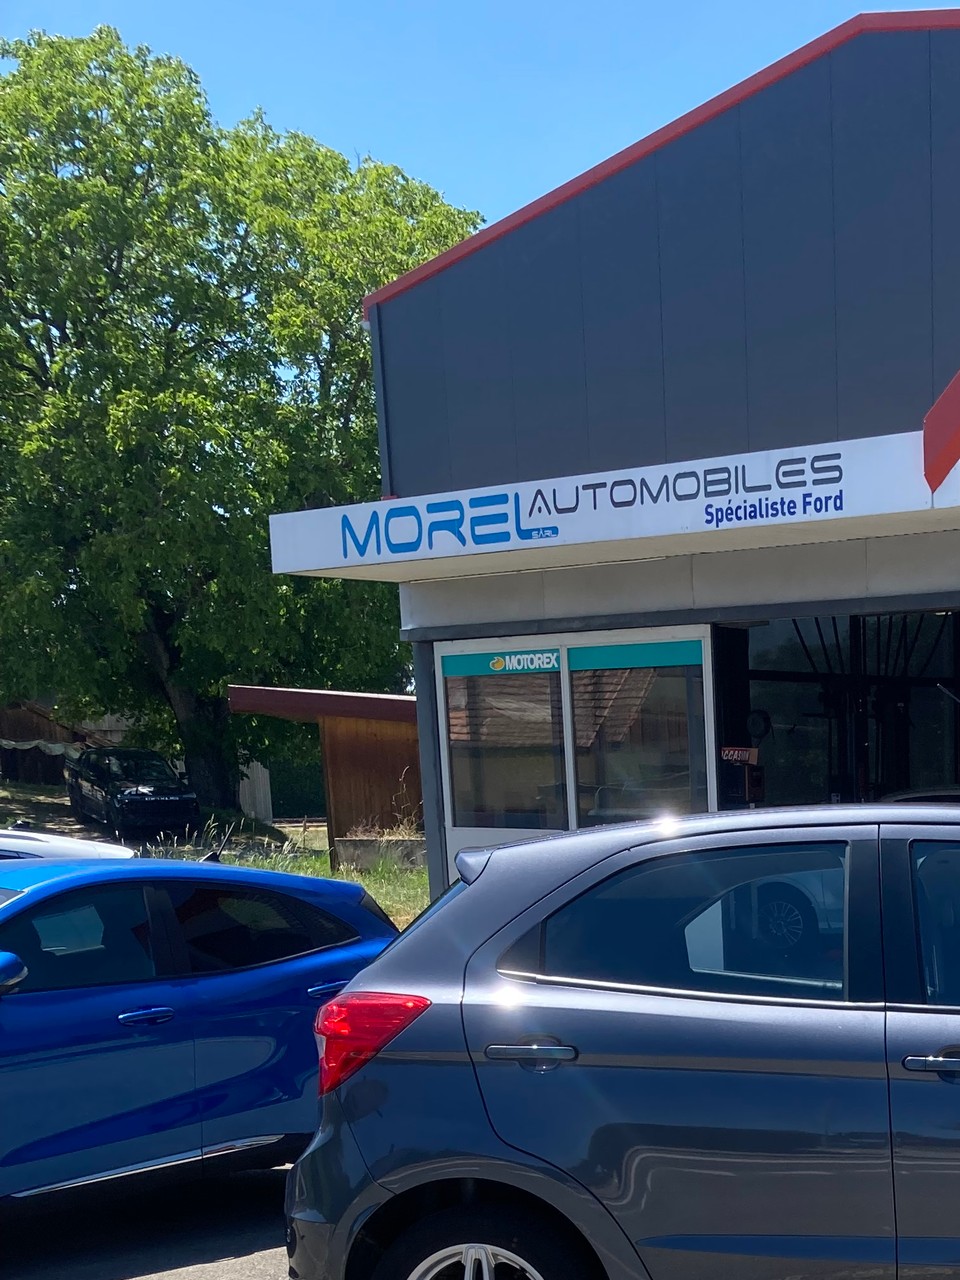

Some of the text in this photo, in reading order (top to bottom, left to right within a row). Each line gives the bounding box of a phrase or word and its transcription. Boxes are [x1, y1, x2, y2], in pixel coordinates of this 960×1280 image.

[340, 452, 843, 560] MOREL AUTOMOBILES
[704, 489, 844, 528] Spécialiste Ford
[505, 652, 559, 671] MOTOREX
